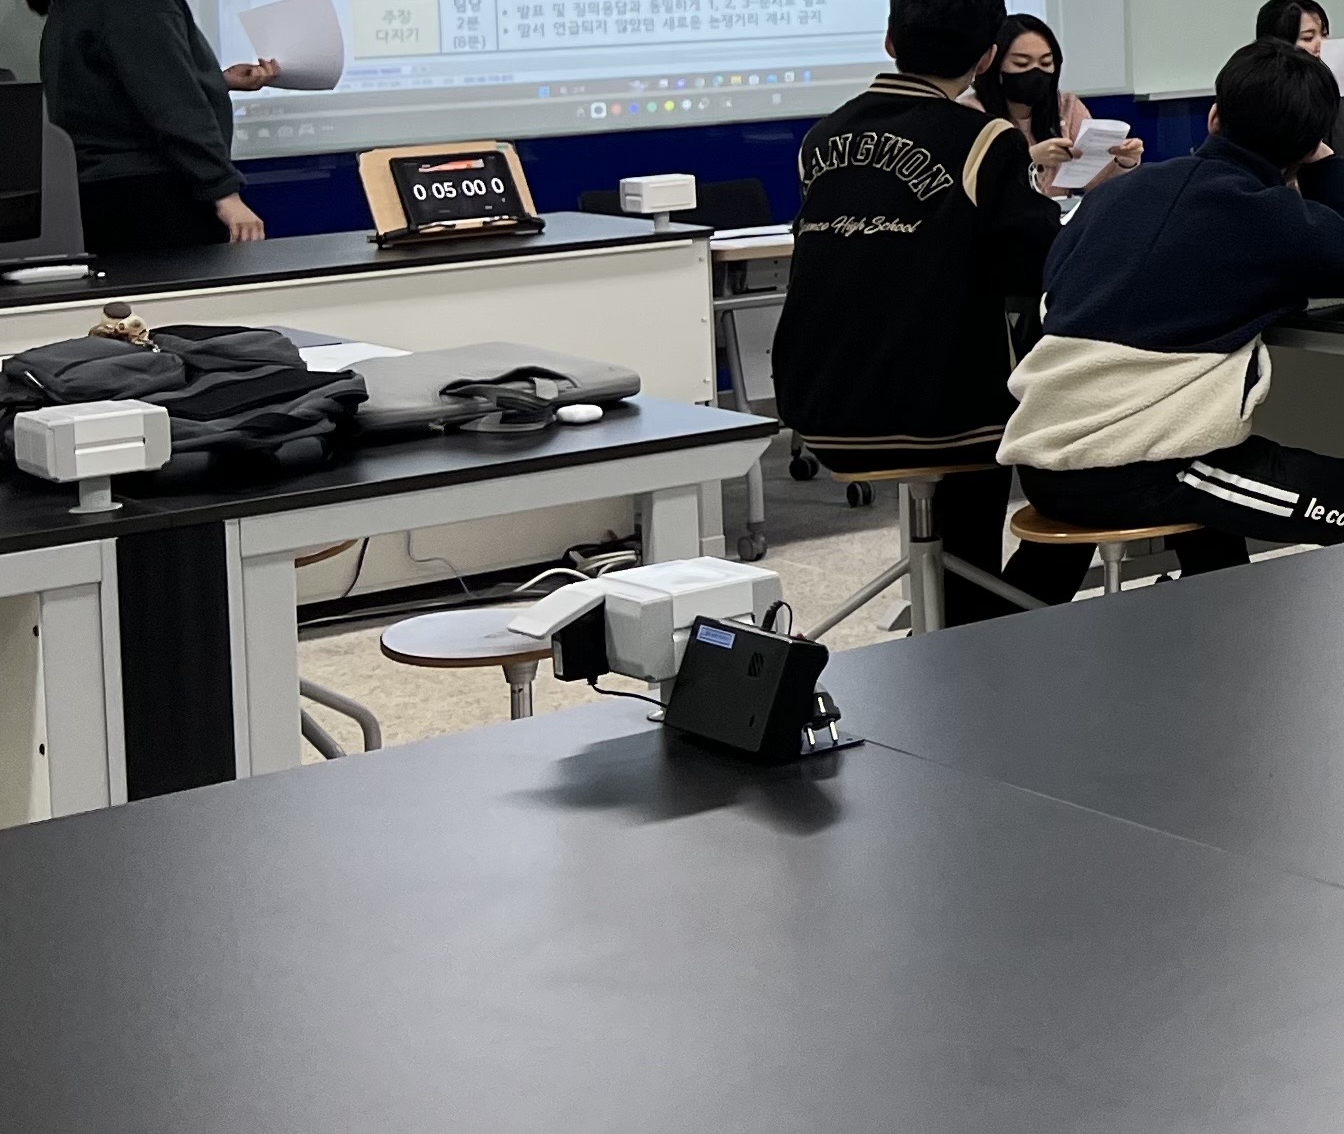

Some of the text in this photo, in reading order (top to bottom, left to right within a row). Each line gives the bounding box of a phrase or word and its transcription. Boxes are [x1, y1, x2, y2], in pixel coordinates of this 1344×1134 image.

[801, 132, 954, 201] ANGWON
[432, 181, 457, 199] 05
[462, 179, 487, 197] 00
[831, 216, 867, 237] High
[864, 216, 922, 234] School
[1304, 497, 1325, 520] le
